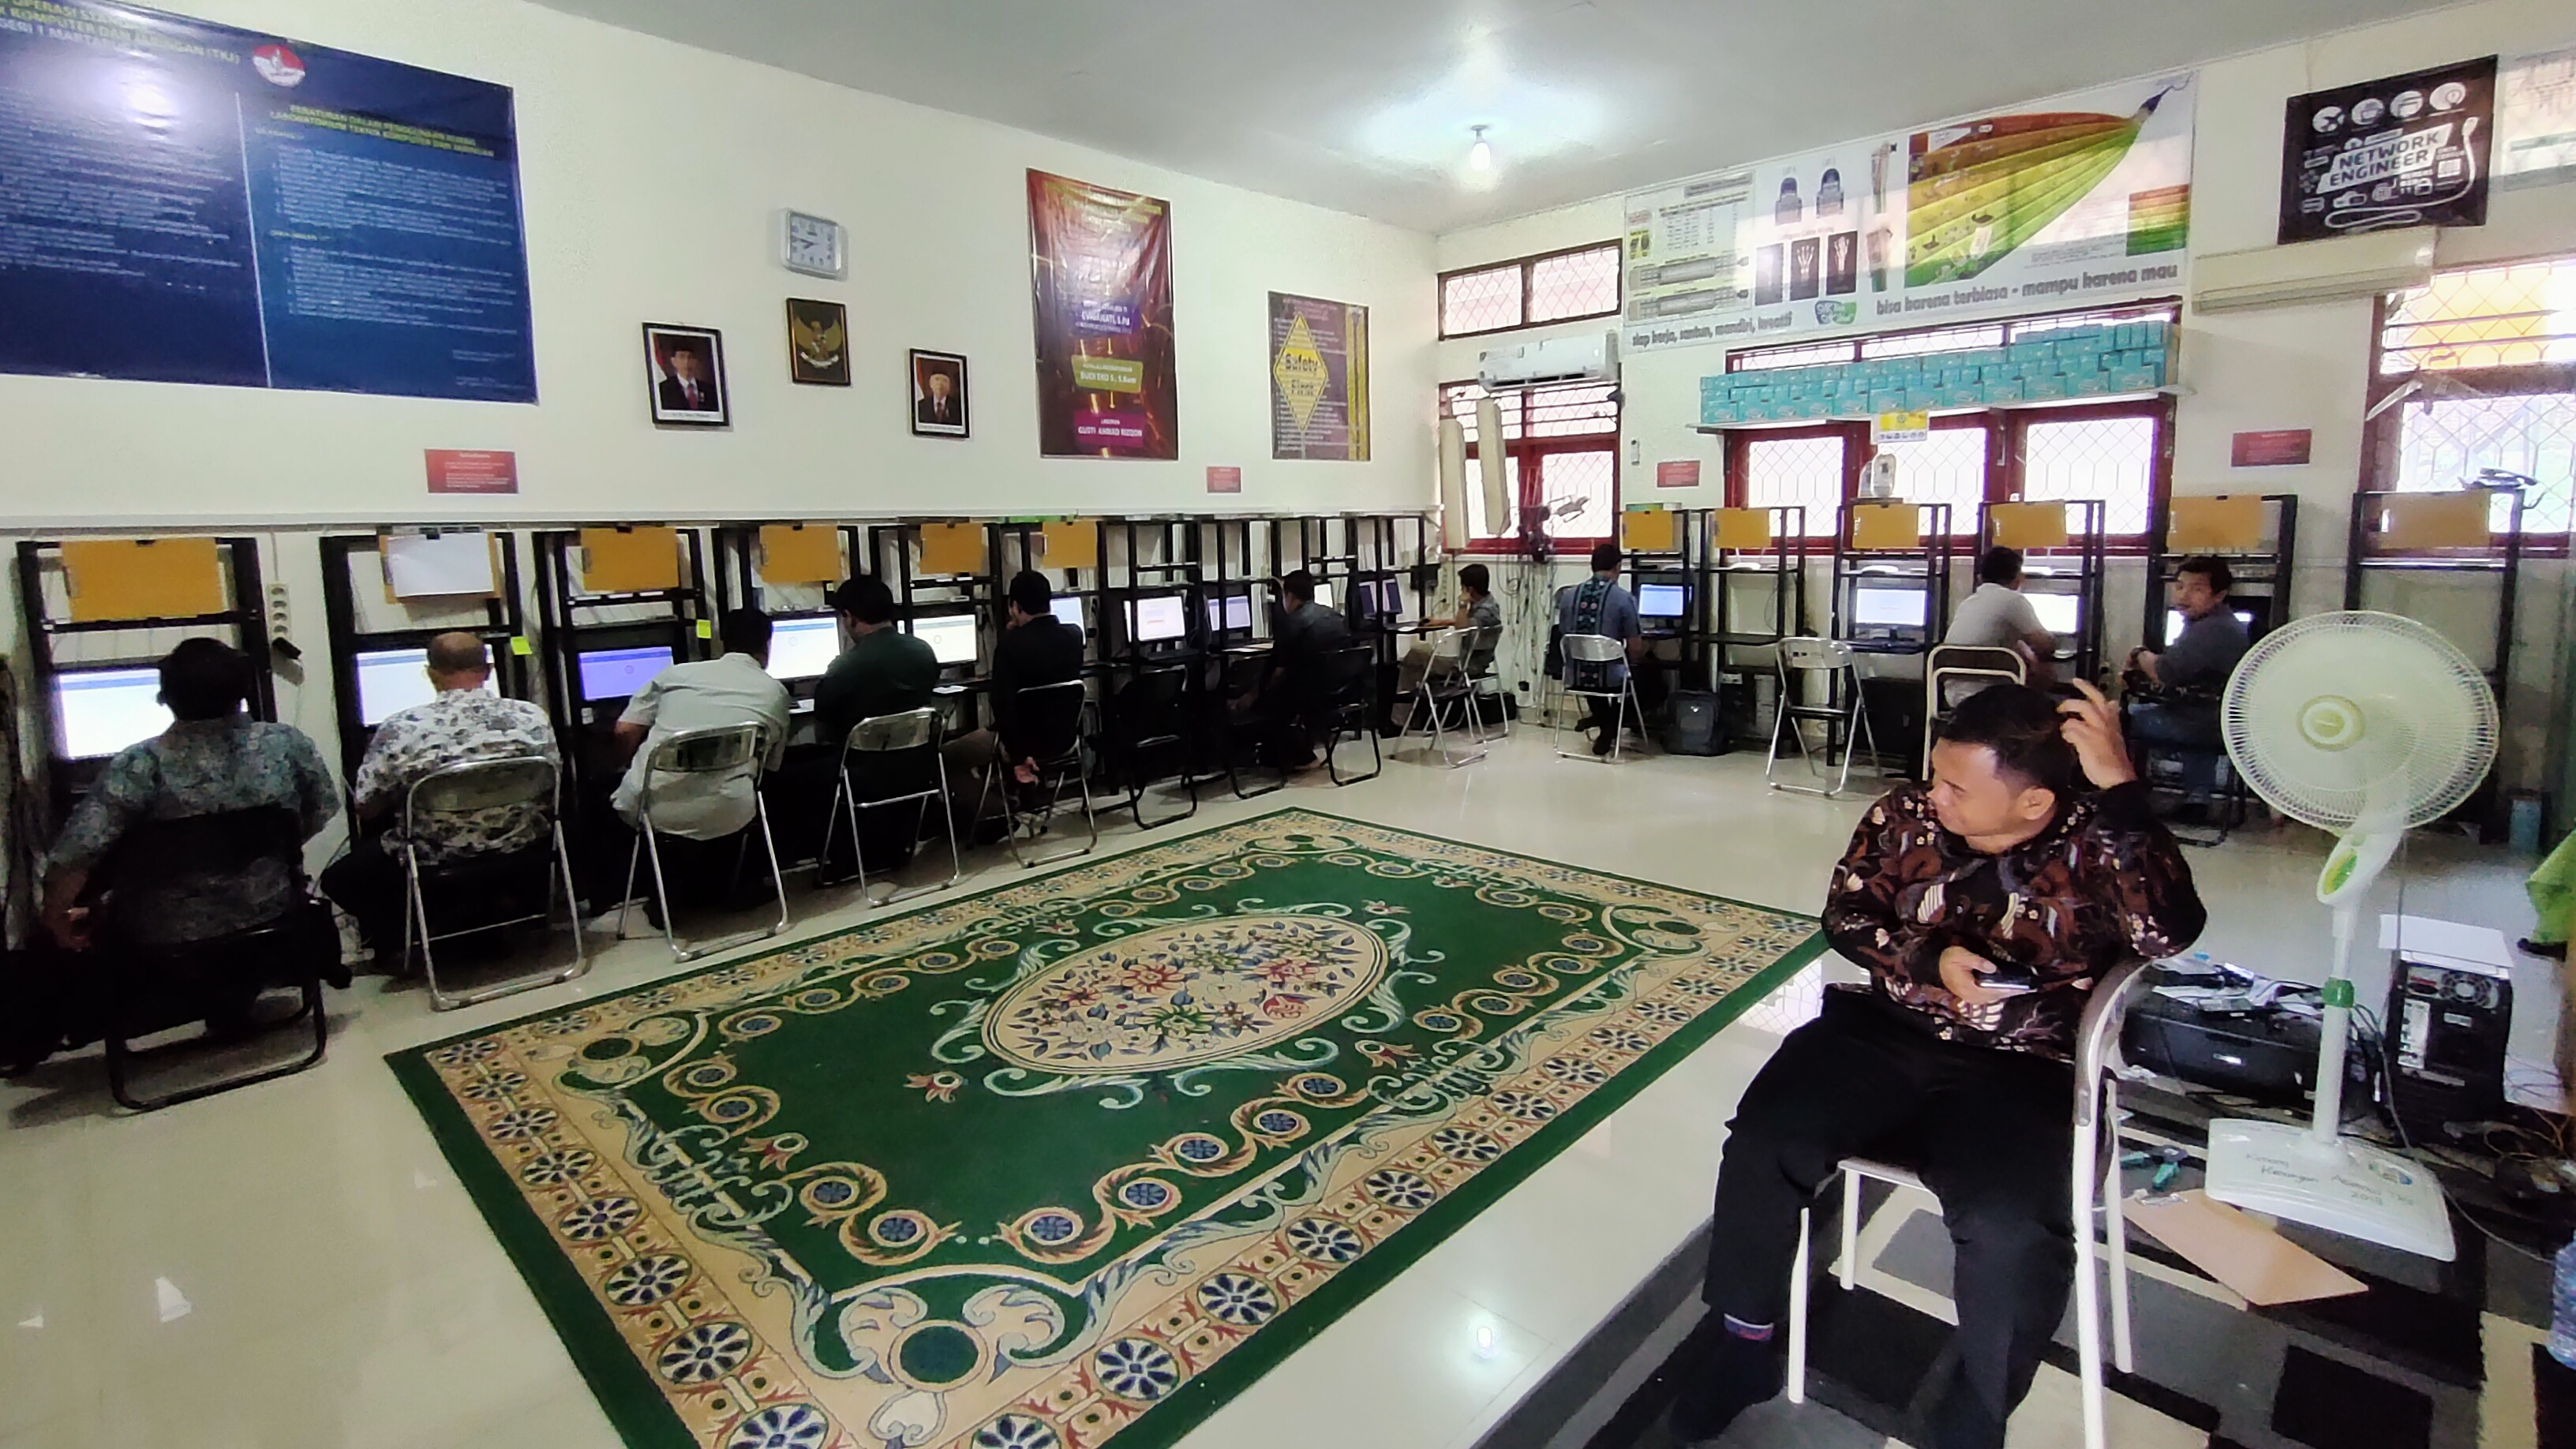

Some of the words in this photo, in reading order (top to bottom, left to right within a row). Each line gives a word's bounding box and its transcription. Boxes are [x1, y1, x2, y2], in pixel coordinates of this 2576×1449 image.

[2330, 149, 2428, 187] ENGINEER
[2338, 132, 2439, 170] NETWORK
[1876, 299, 1901, 315] bisa
[1904, 292, 1950, 312] karena
[1953, 286, 2008, 305] terbiasa
[2022, 276, 2078, 298] mampu
[2082, 271, 2138, 289] karena
[2140, 264, 2178, 281] mau
[1285, 354, 1318, 375] Safety
